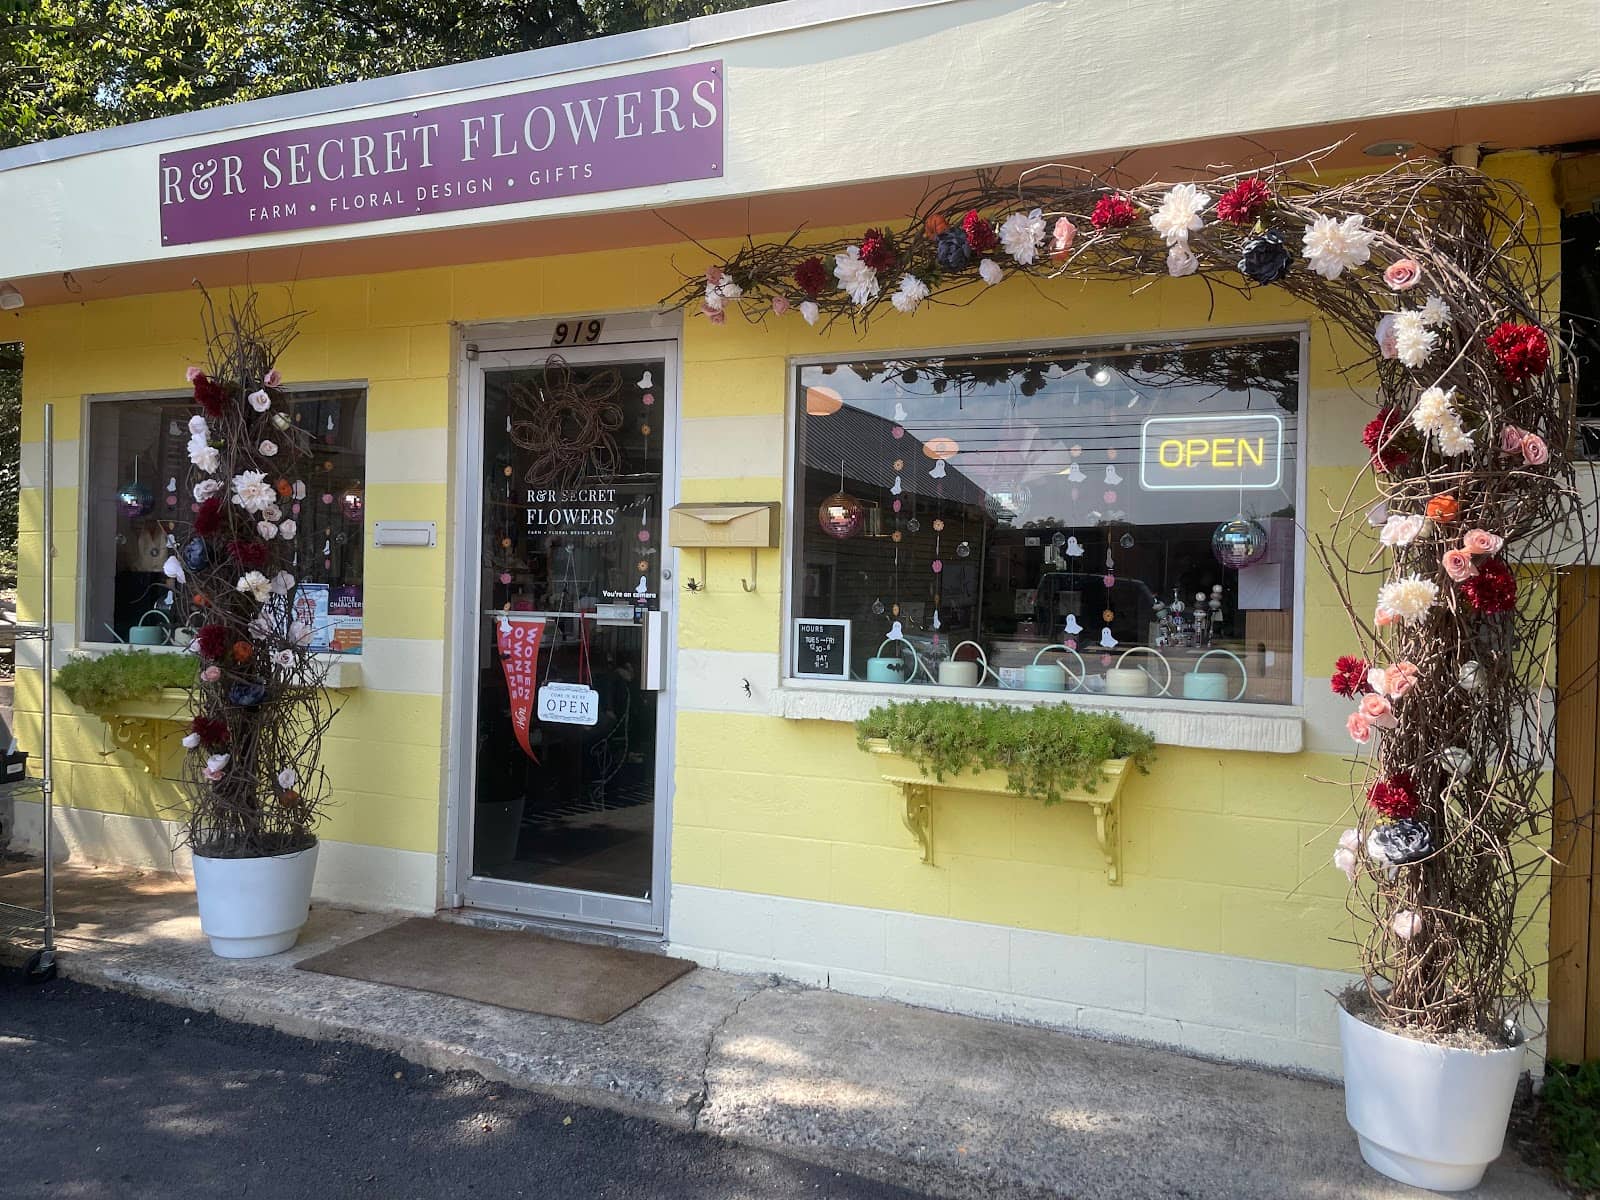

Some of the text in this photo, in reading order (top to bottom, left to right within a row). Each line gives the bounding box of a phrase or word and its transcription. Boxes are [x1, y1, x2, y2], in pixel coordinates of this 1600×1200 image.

[162, 80, 717, 205] R&R SECRET FLOWERS
[250, 163, 593, 221] FARM FLORAL DESIGN GIFTS
[1159, 437, 1264, 468] OPEN
[527, 489, 616, 502] R&R SECRET
[526, 508, 615, 525] FLOWERS
[602, 590, 622, 598] You're
[801, 625, 824, 633] HOURS
[514, 626, 525, 697] OWNED
[524, 626, 538, 700] WOMEN
[815, 654, 828, 662] SAT
[546, 699, 590, 714] OPEN
